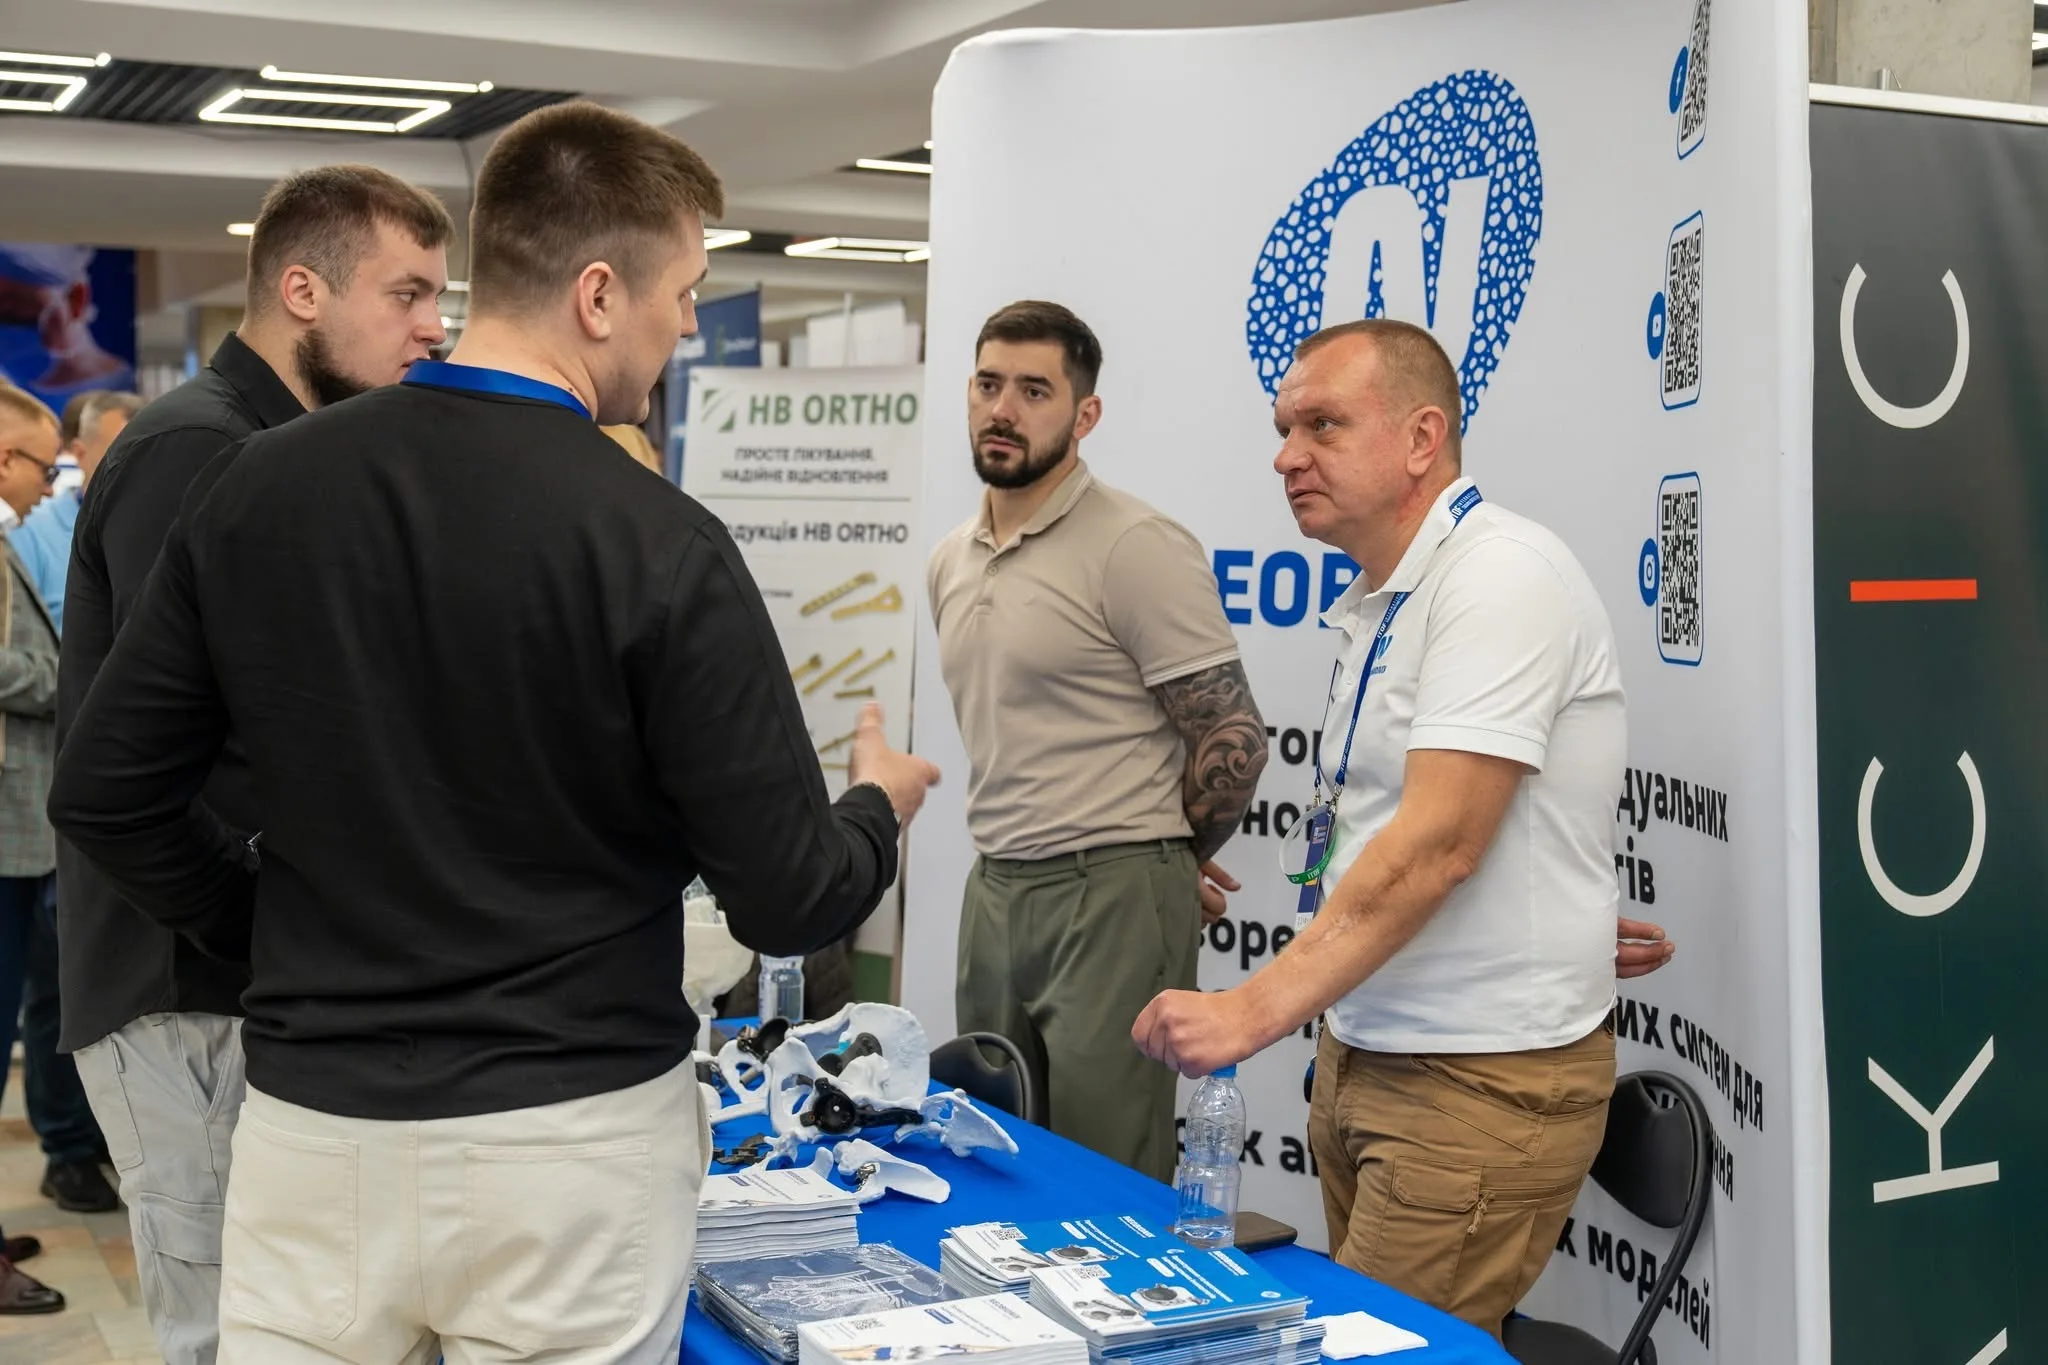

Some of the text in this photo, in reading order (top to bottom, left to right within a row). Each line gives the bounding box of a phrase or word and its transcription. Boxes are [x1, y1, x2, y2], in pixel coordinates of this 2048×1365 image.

[748, 393, 918, 426] HB ORTHO
[731, 521, 909, 544] дукція HB ORTHO
[1670, 1013, 1730, 1101] систем
[1733, 1061, 1764, 1133] для
[1587, 1224, 1710, 1351] модлей
